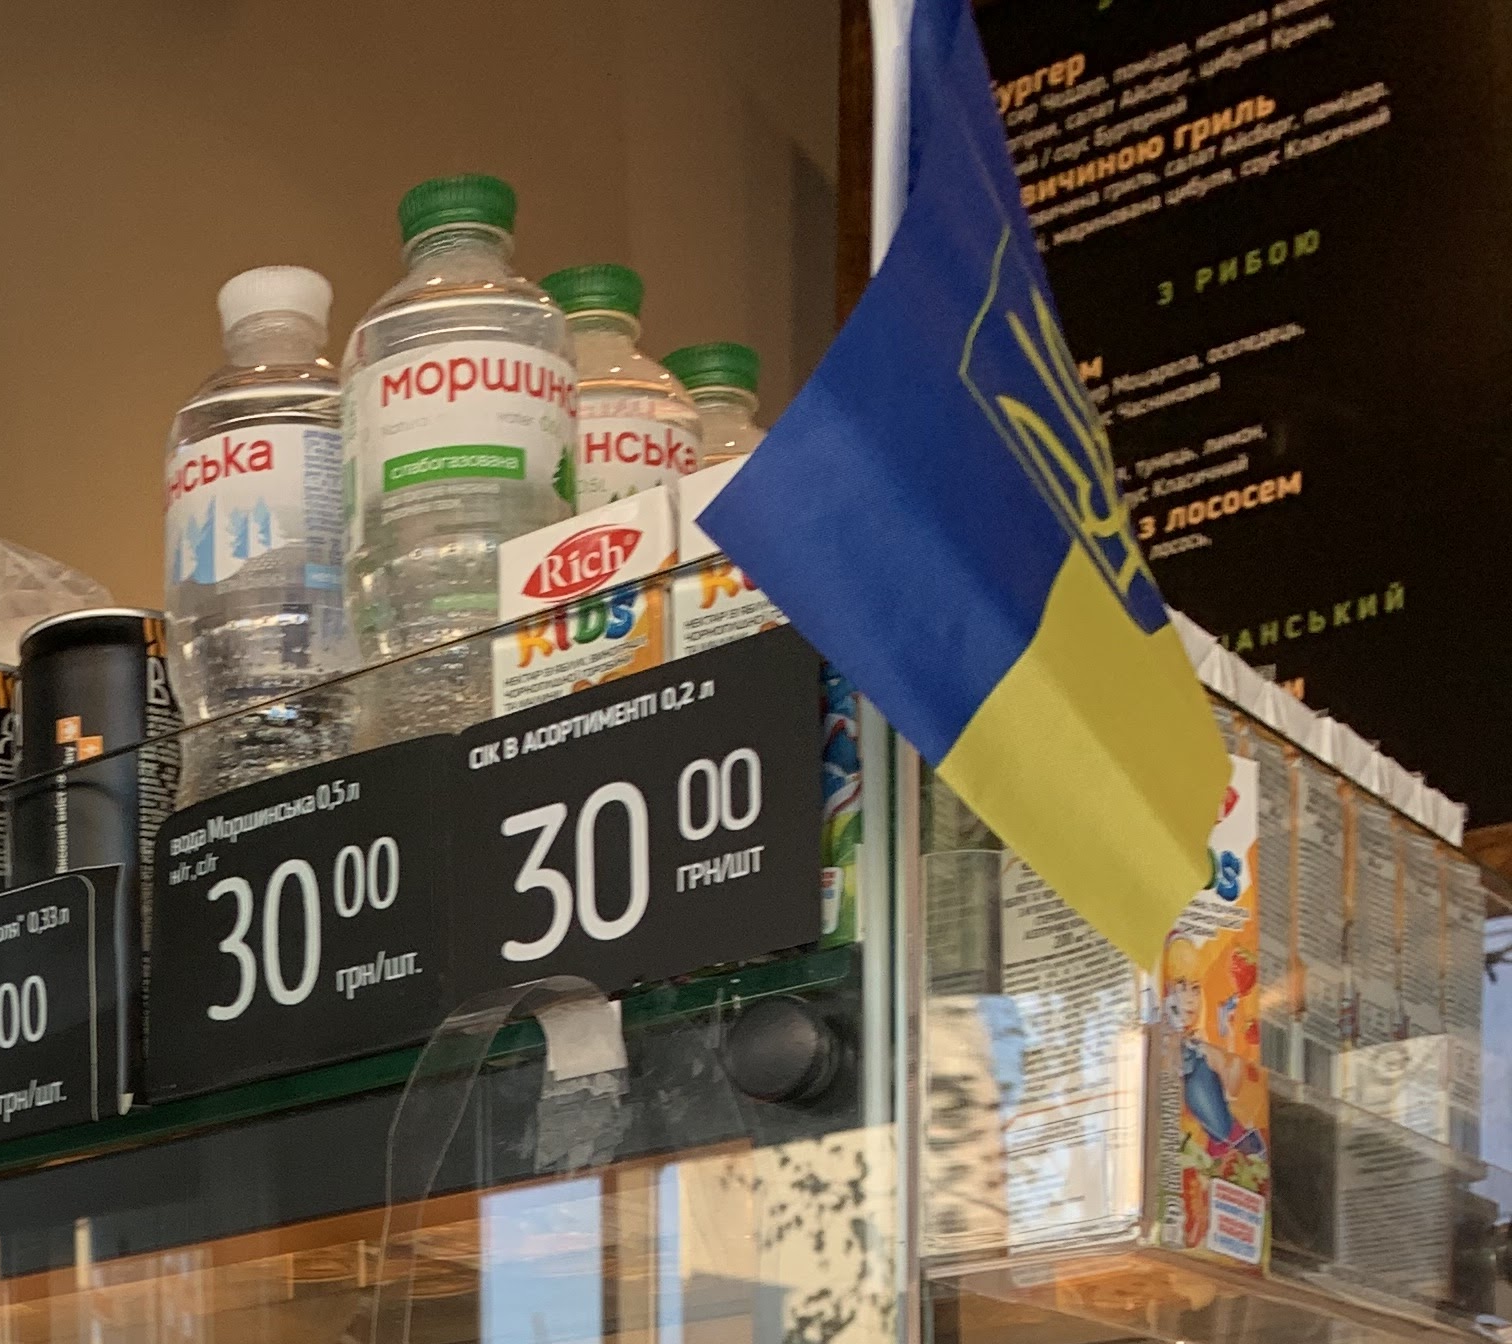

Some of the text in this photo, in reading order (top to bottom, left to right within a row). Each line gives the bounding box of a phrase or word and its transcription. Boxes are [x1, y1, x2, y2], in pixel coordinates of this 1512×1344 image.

[1174, 94, 1276, 150] гриль
[1157, 229, 1320, 305] З РИБОЮ
[1138, 470, 1303, 540] з лососем
[538, 535, 626, 594] Rich
[468, 743, 500, 770] СІК
[502, 736, 519, 760] В
[521, 692, 657, 754] АСОРТИМЕНТІ
[660, 681, 695, 710] 0,2
[698, 679, 716, 700] л
[170, 828, 207, 857] вода
[207, 795, 316, 843] Моршинська
[500, 747, 762, 962] 30 00
[676, 845, 765, 893] ГРН/ШТ
[207, 837, 400, 1021] 30 00
[336, 951, 423, 1000] грн/шт.
